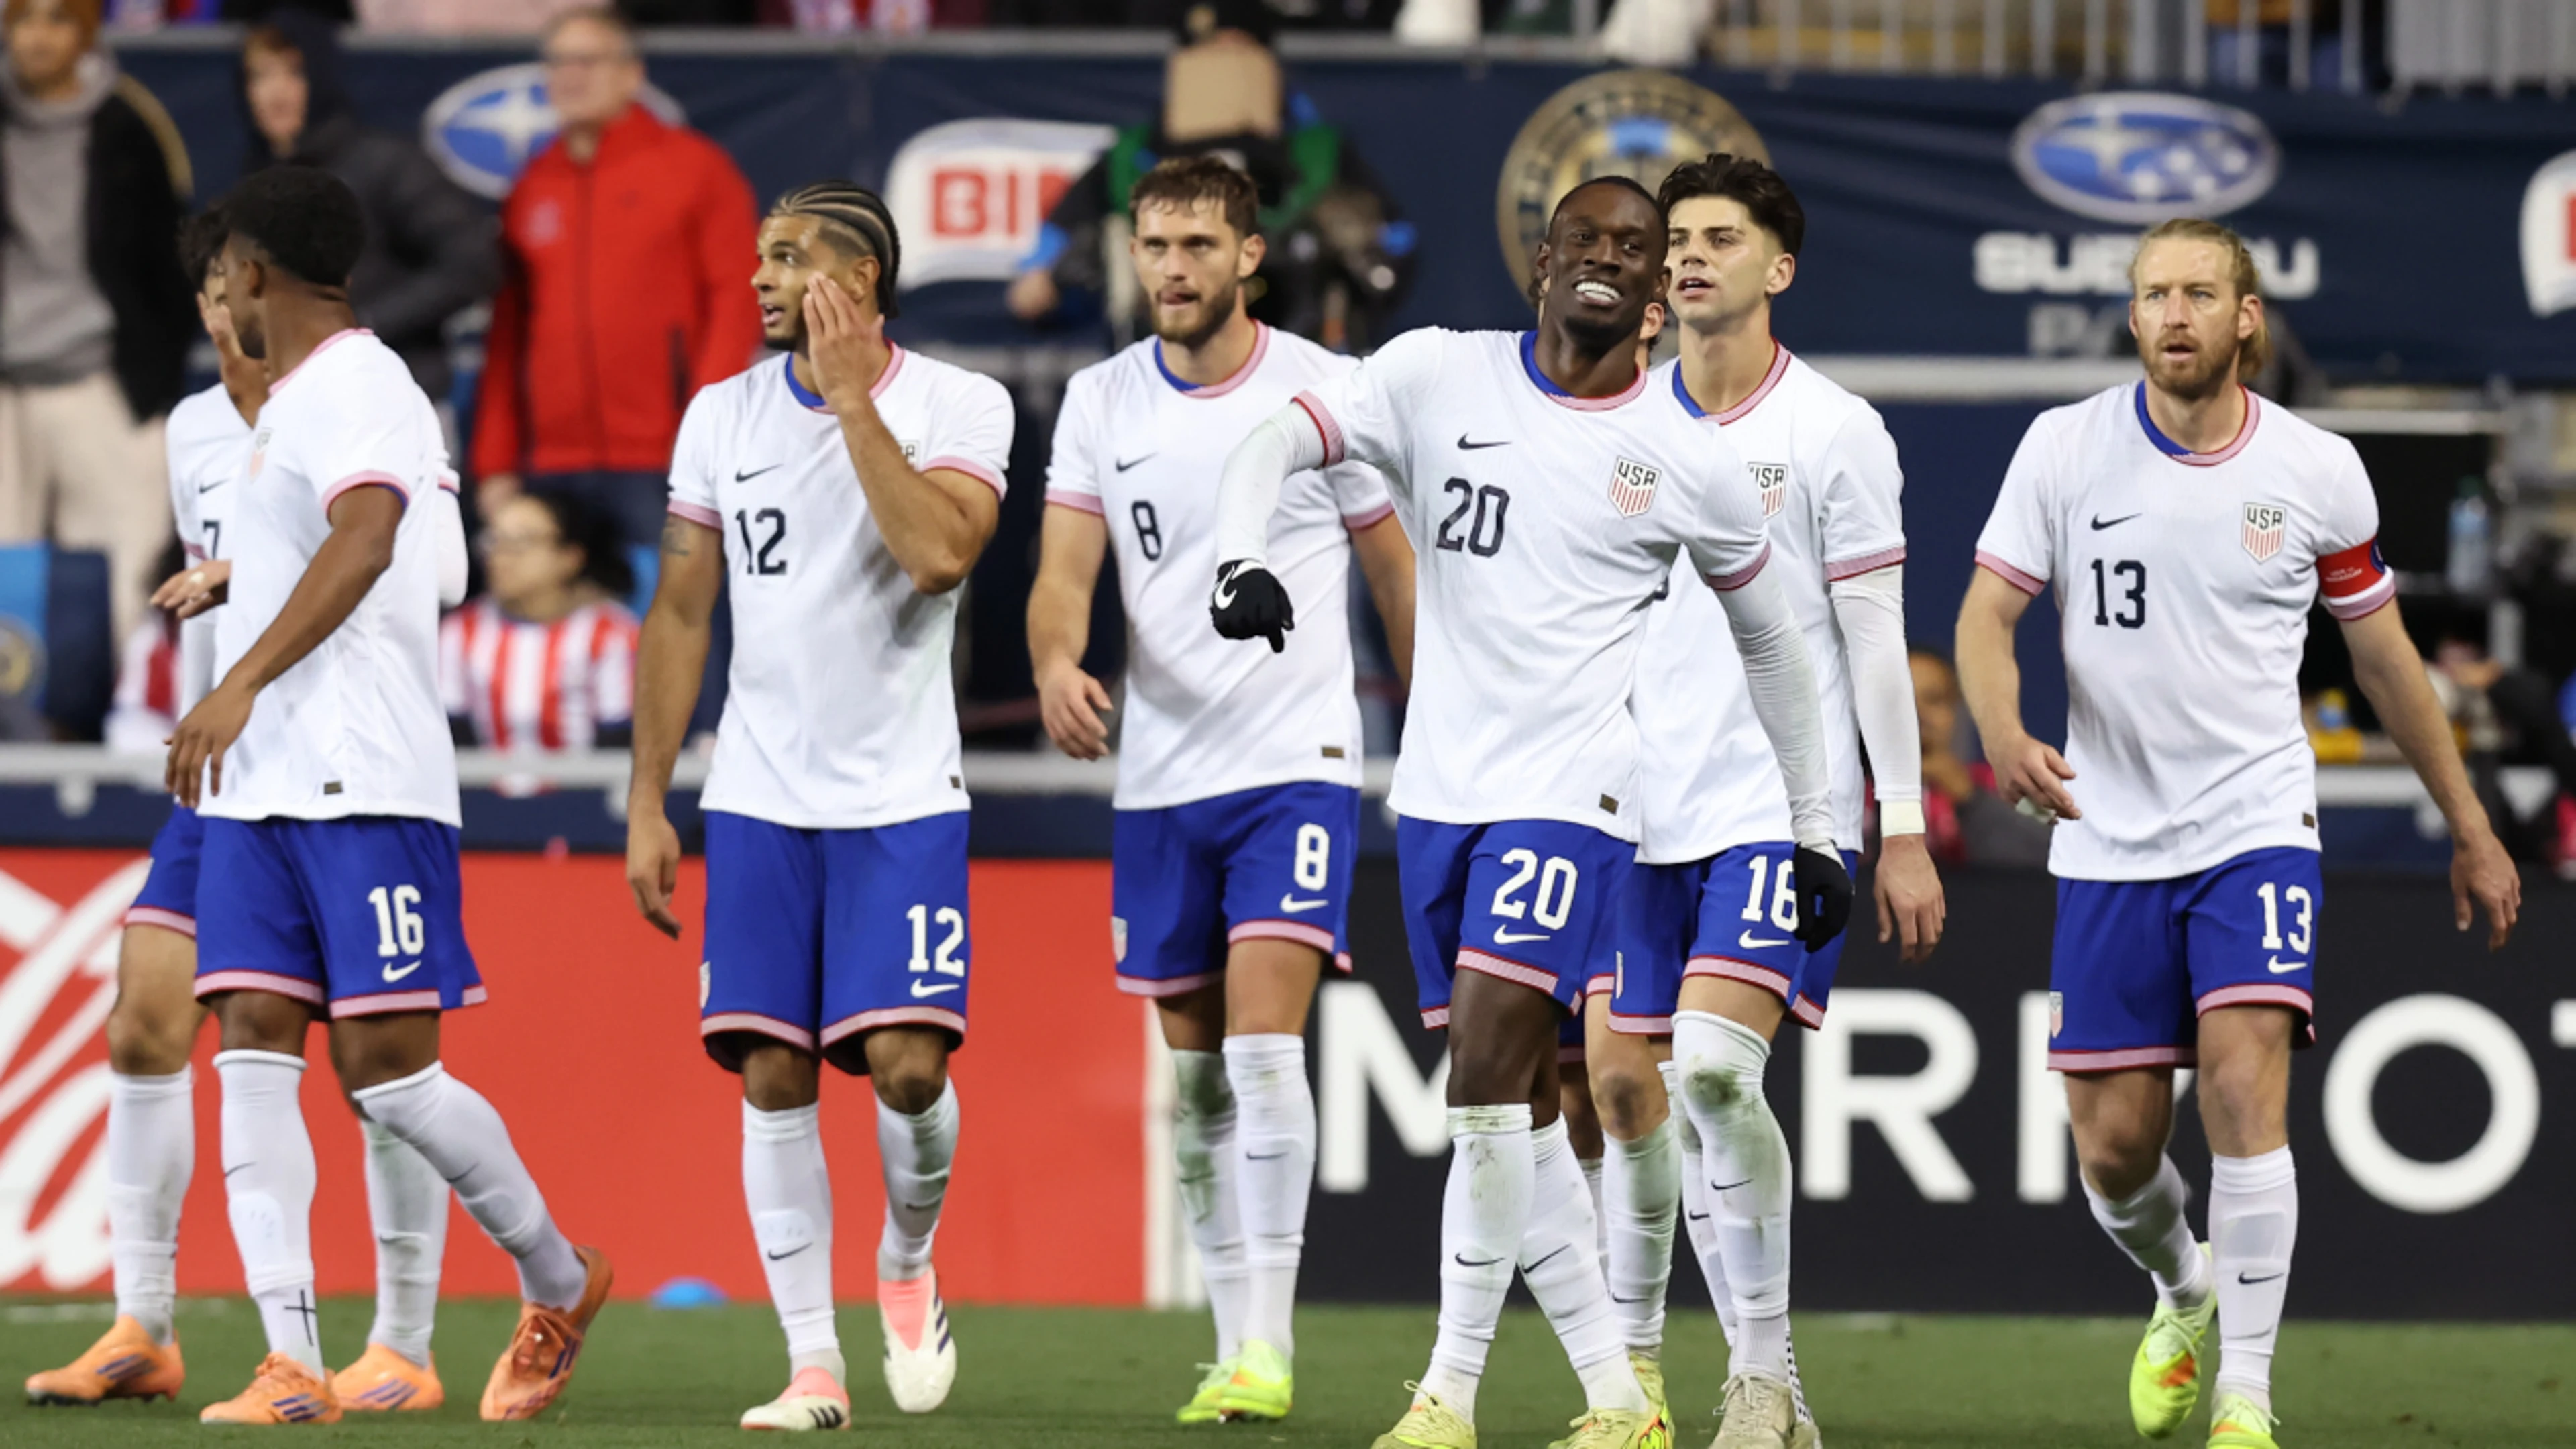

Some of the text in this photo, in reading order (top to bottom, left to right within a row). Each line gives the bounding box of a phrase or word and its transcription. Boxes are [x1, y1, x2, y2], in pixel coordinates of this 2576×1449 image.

[1974, 233, 2319, 299] SUBU
[1617, 461, 1656, 486] USA
[203, 520, 220, 560] 7
[735, 508, 787, 575] 12
[1131, 500, 1162, 561] 8
[1435, 476, 1511, 558] 20
[2247, 506, 2283, 530] USA
[2090, 559, 2146, 629] 13
[1294, 823, 1330, 891] 8
[1491, 848, 1578, 930] 20
[368, 885, 423, 957] 16
[1741, 855, 1800, 932] 16
[2257, 882, 2312, 954] 13
[906, 904, 965, 977] 12
